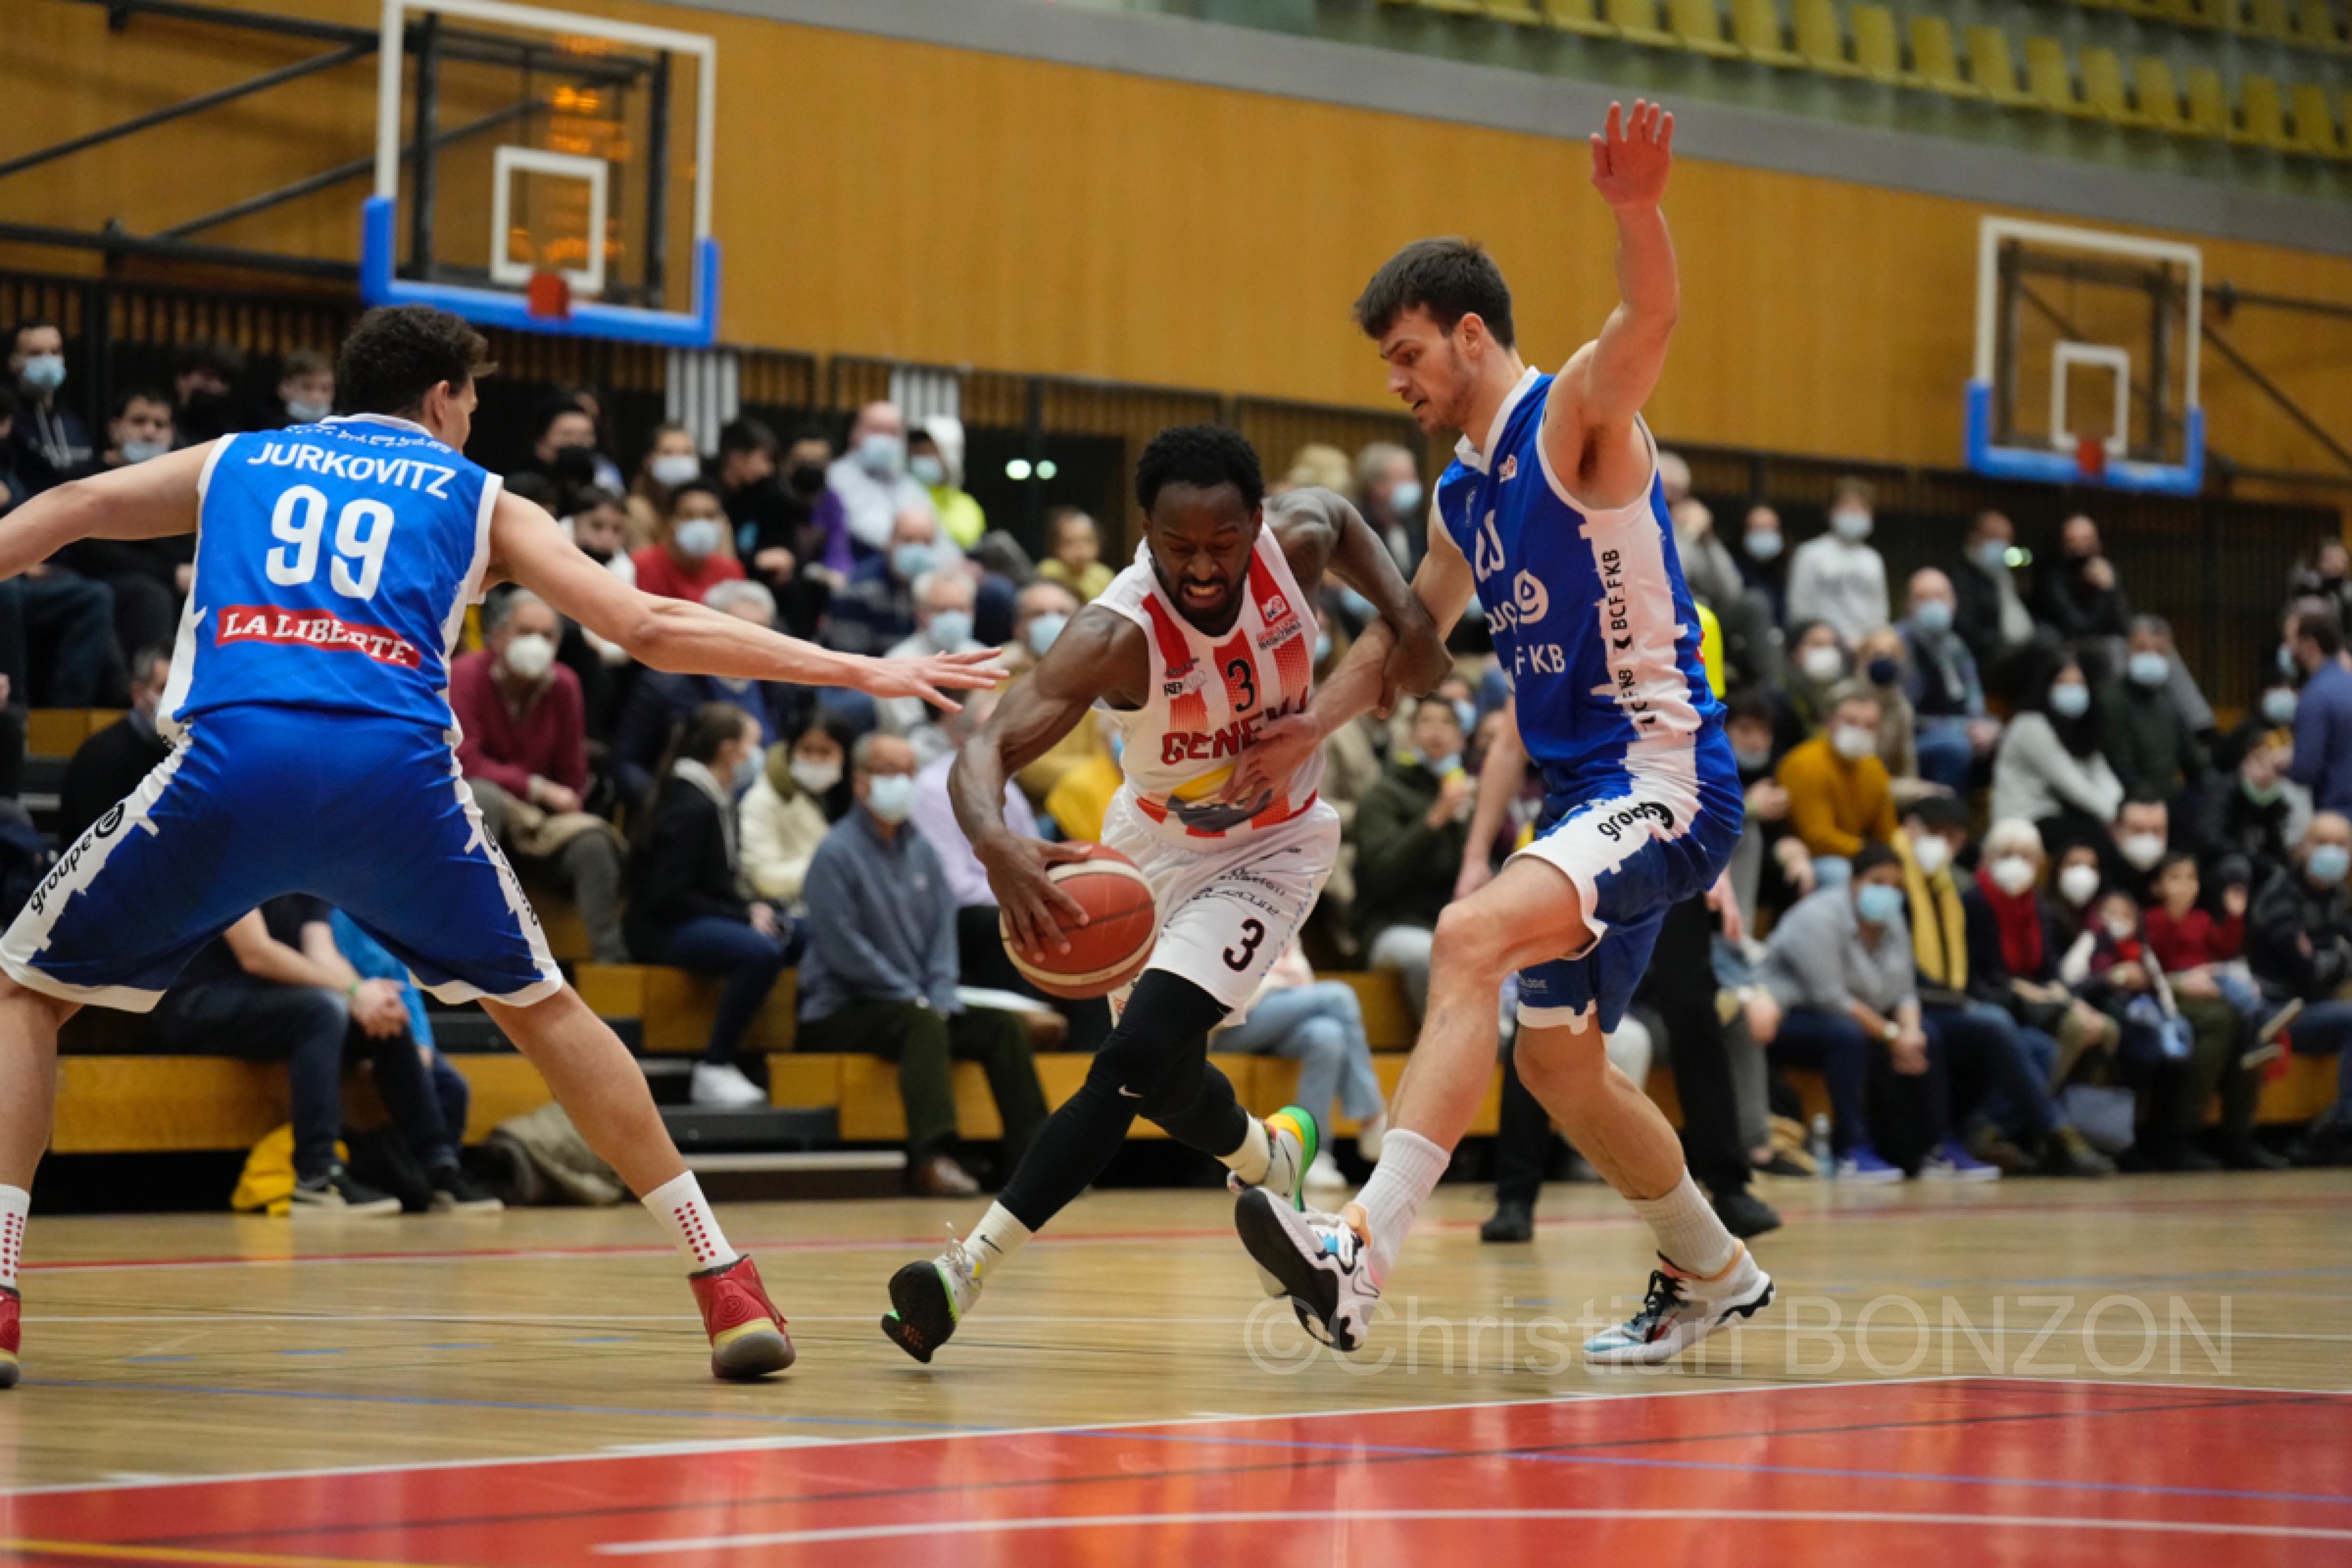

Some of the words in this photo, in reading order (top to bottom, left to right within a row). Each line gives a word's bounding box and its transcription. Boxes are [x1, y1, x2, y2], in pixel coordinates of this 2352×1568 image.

[247, 442, 456, 500] JURKOVITZ
[266, 484, 395, 603] 99
[223, 612, 268, 638] LA
[1227, 658, 1255, 712] 3
[30, 832, 92, 916] groupe
[1223, 917, 1265, 972] 3
